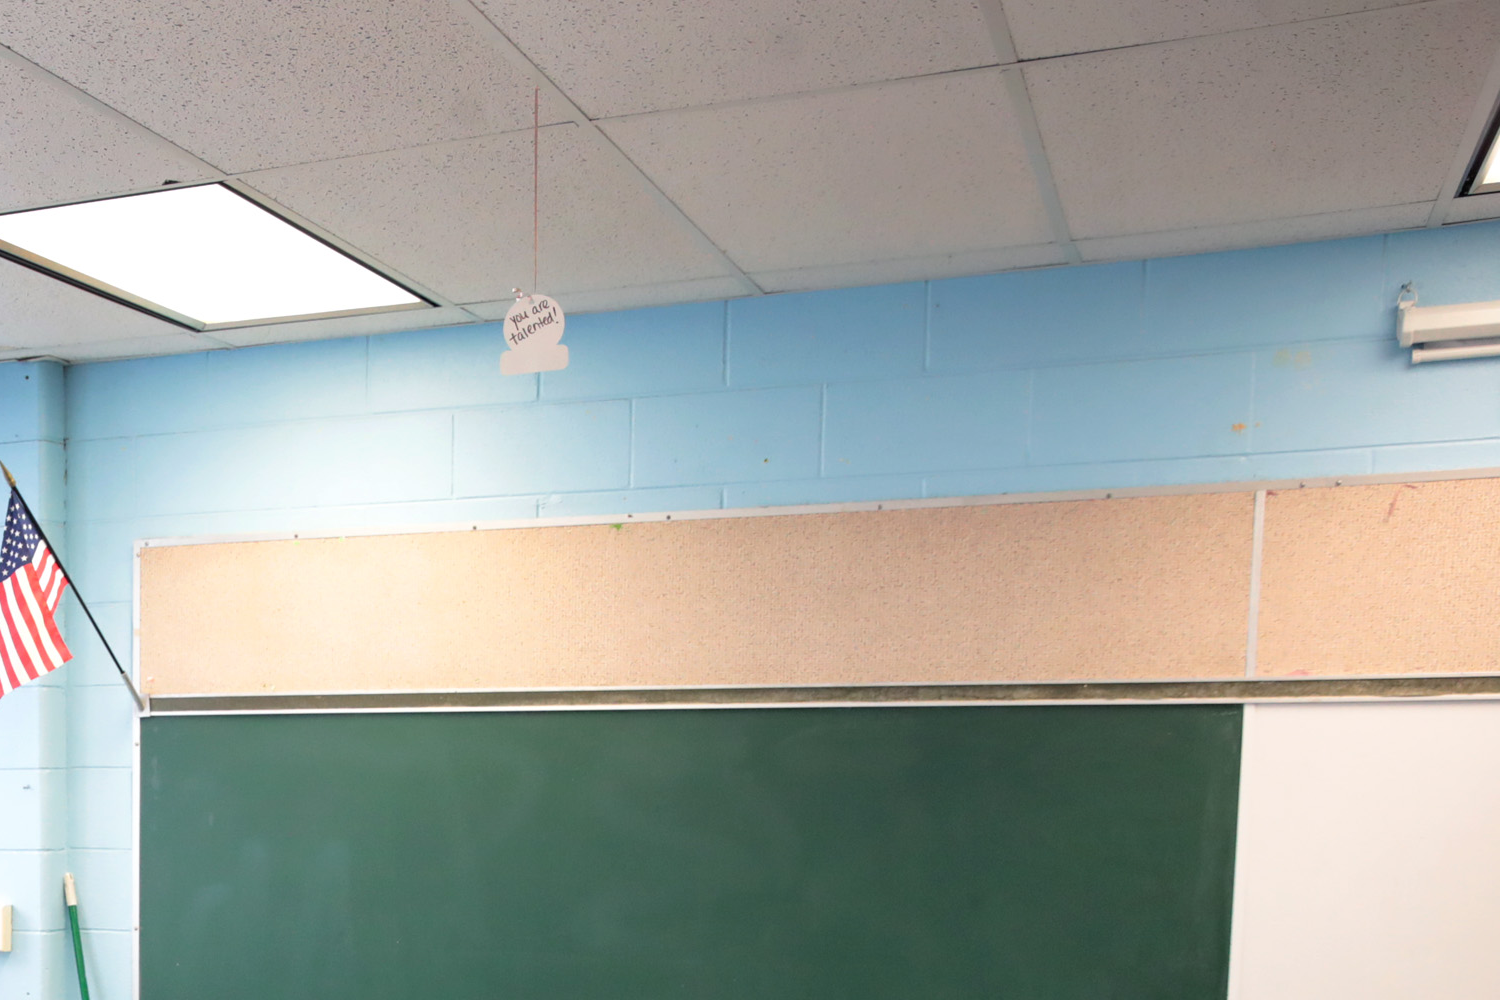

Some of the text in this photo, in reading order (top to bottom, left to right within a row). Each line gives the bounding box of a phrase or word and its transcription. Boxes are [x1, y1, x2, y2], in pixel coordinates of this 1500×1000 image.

[509, 299, 550, 331] you are
[509, 306, 559, 345] talented!
